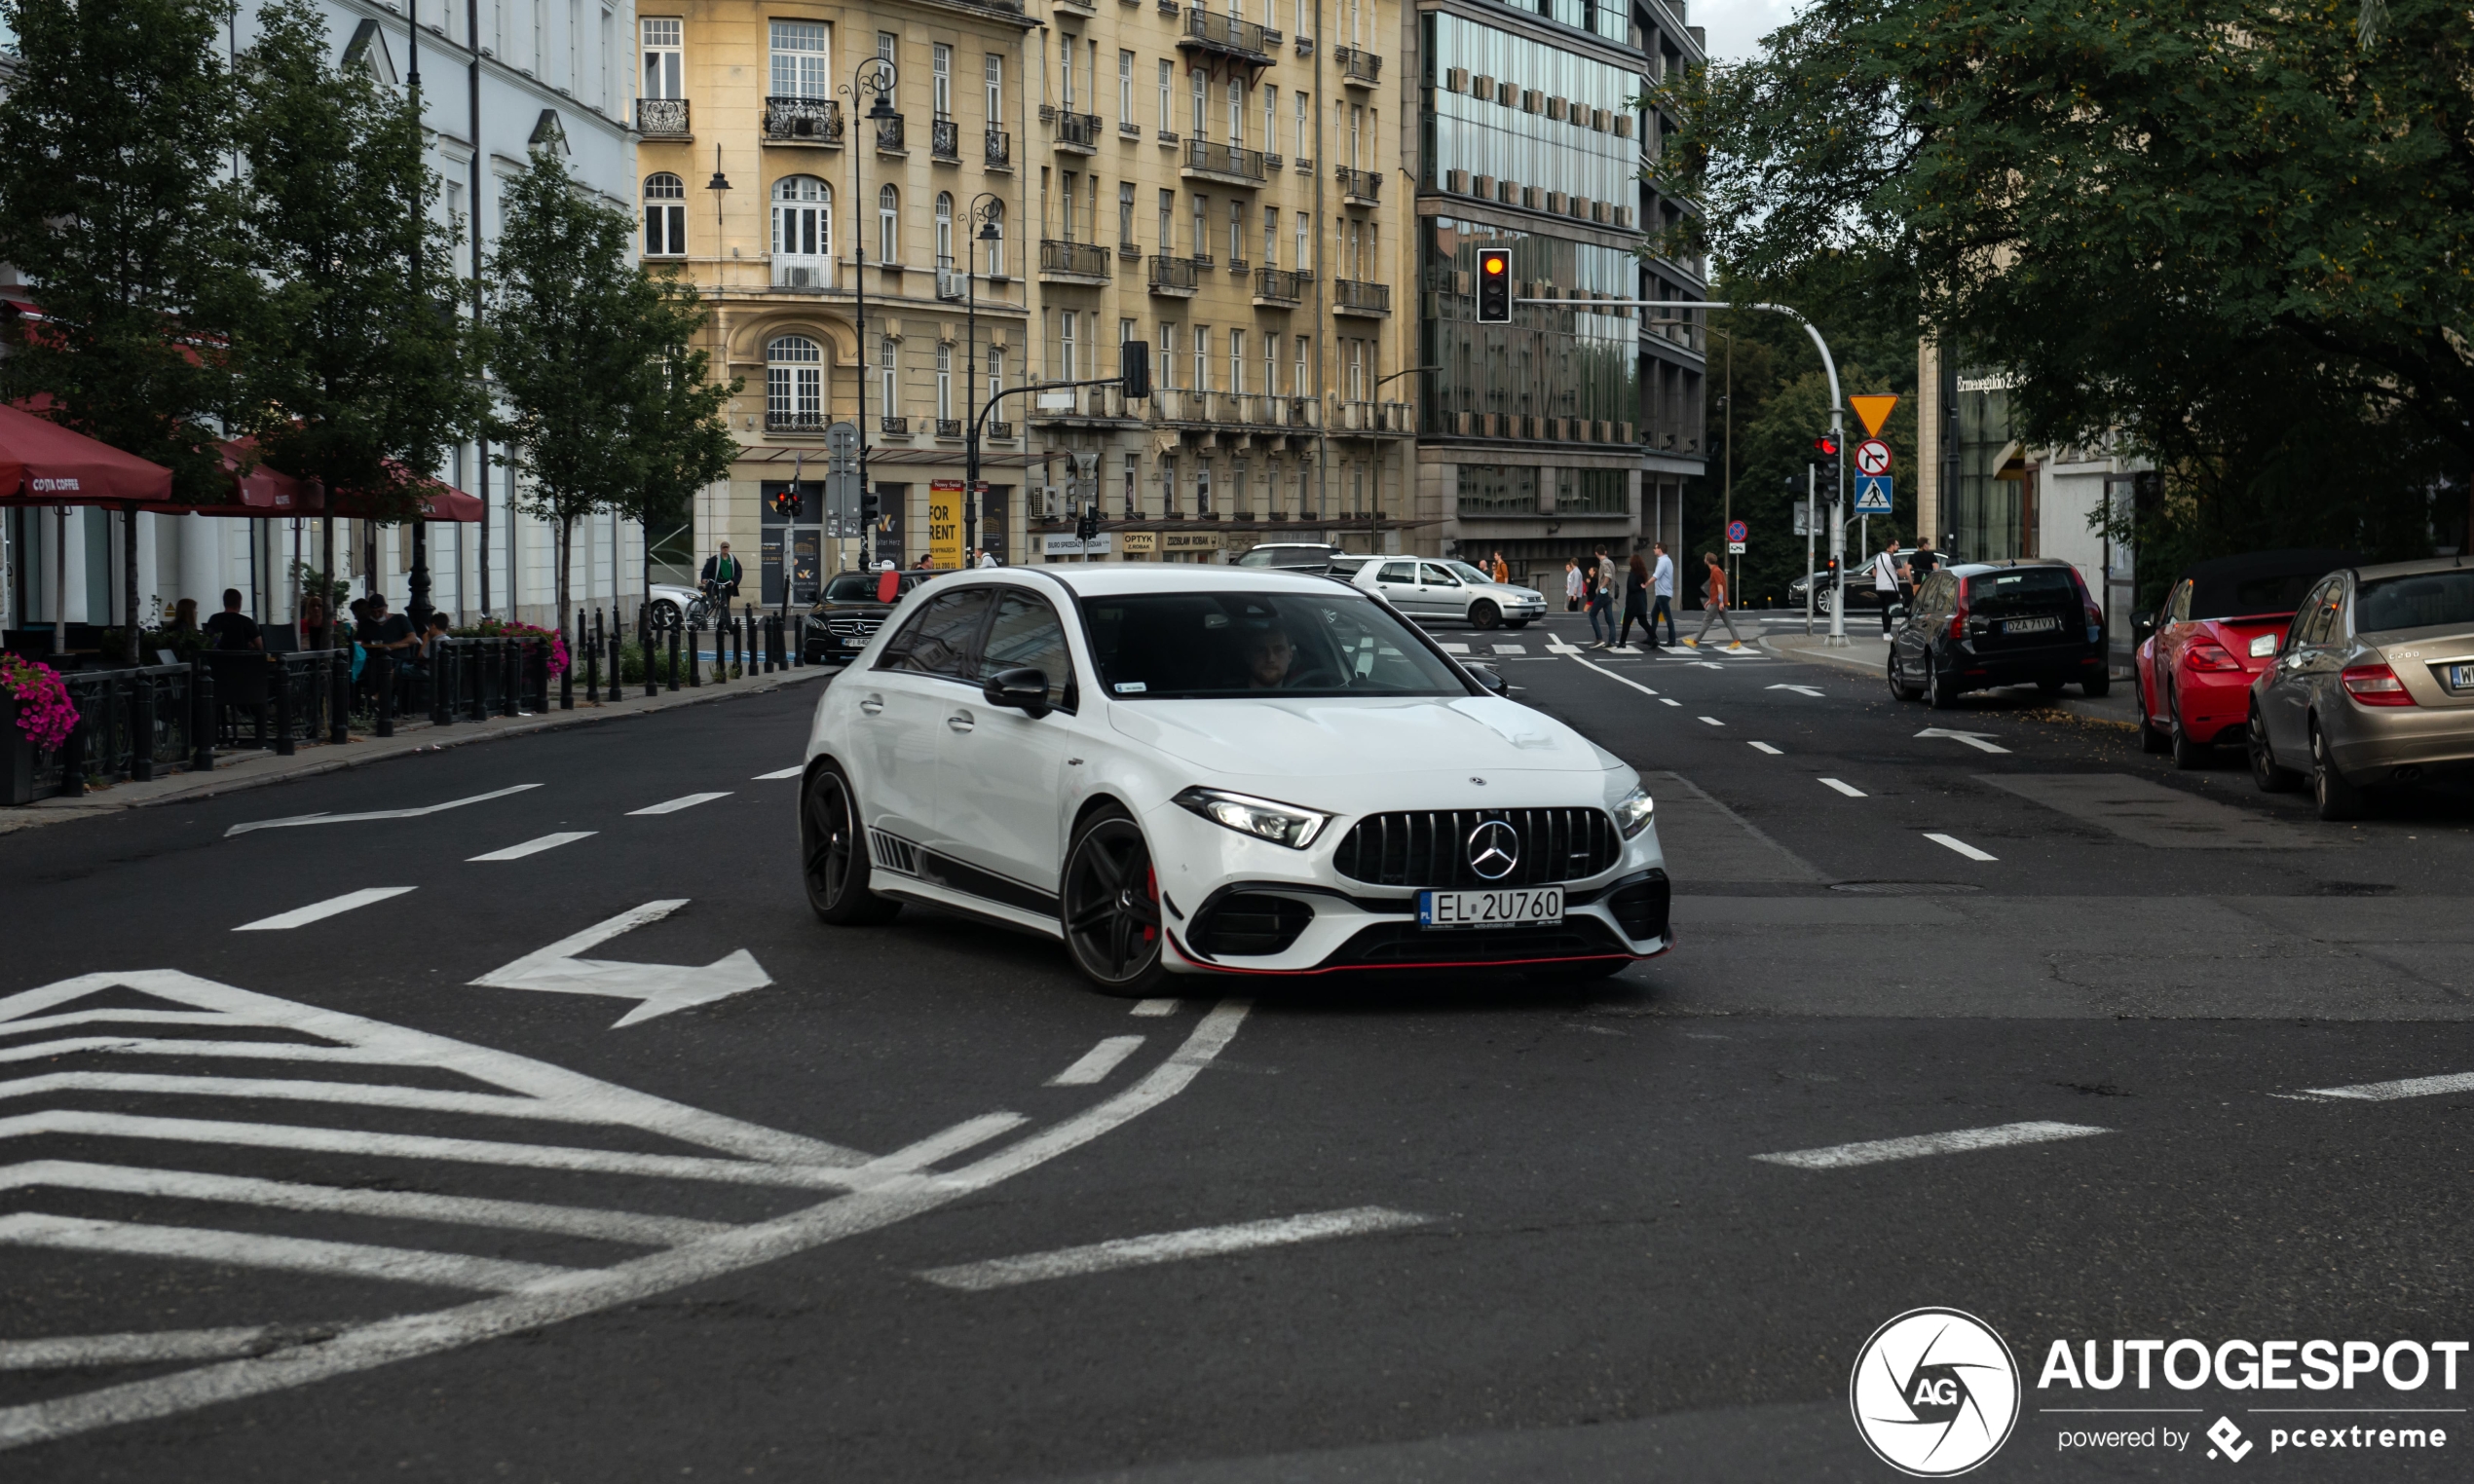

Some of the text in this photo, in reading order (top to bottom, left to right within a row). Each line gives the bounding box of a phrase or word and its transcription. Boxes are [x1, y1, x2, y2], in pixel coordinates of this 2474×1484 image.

[1957, 373, 2005, 394] Ermenegildo
[33, 478, 80, 492] COSTA COFFEE
[929, 505, 949, 521] FOR
[929, 525, 956, 539] RENT
[1192, 536, 1209, 545] ROBAK
[2007, 616, 2054, 632] DZA 71VX
[1438, 891, 1558, 921] EL 2U760
[1420, 911, 1430, 920] PL
